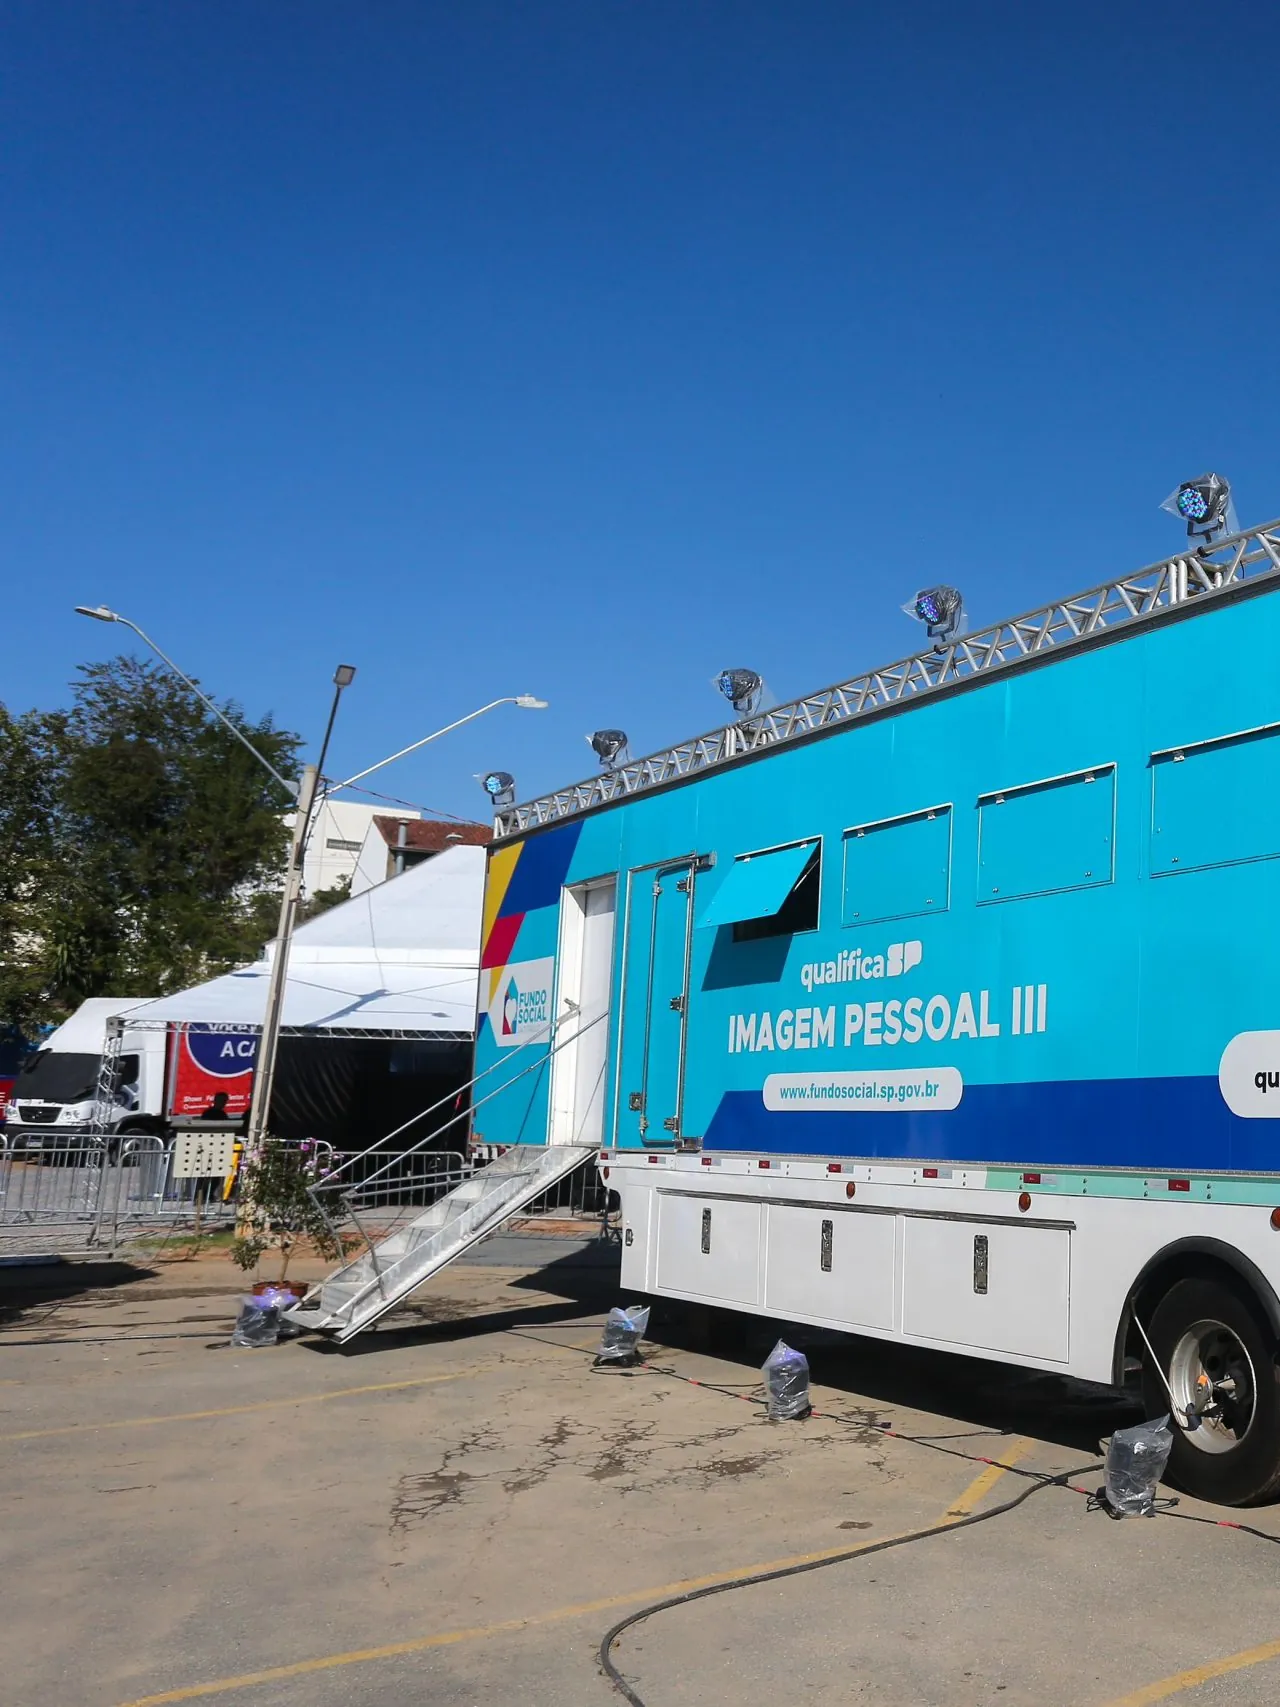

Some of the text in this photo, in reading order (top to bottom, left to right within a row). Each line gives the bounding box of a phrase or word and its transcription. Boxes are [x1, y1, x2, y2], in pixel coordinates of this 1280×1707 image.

[519, 990, 547, 1007] FUNDO
[518, 1006, 547, 1024] SOCIAL
[728, 983, 1048, 1053] IMAGEM PESSOAL III
[220, 1041, 235, 1058] A
[779, 1079, 940, 1102] www.fundosocial.sp.gov.br
